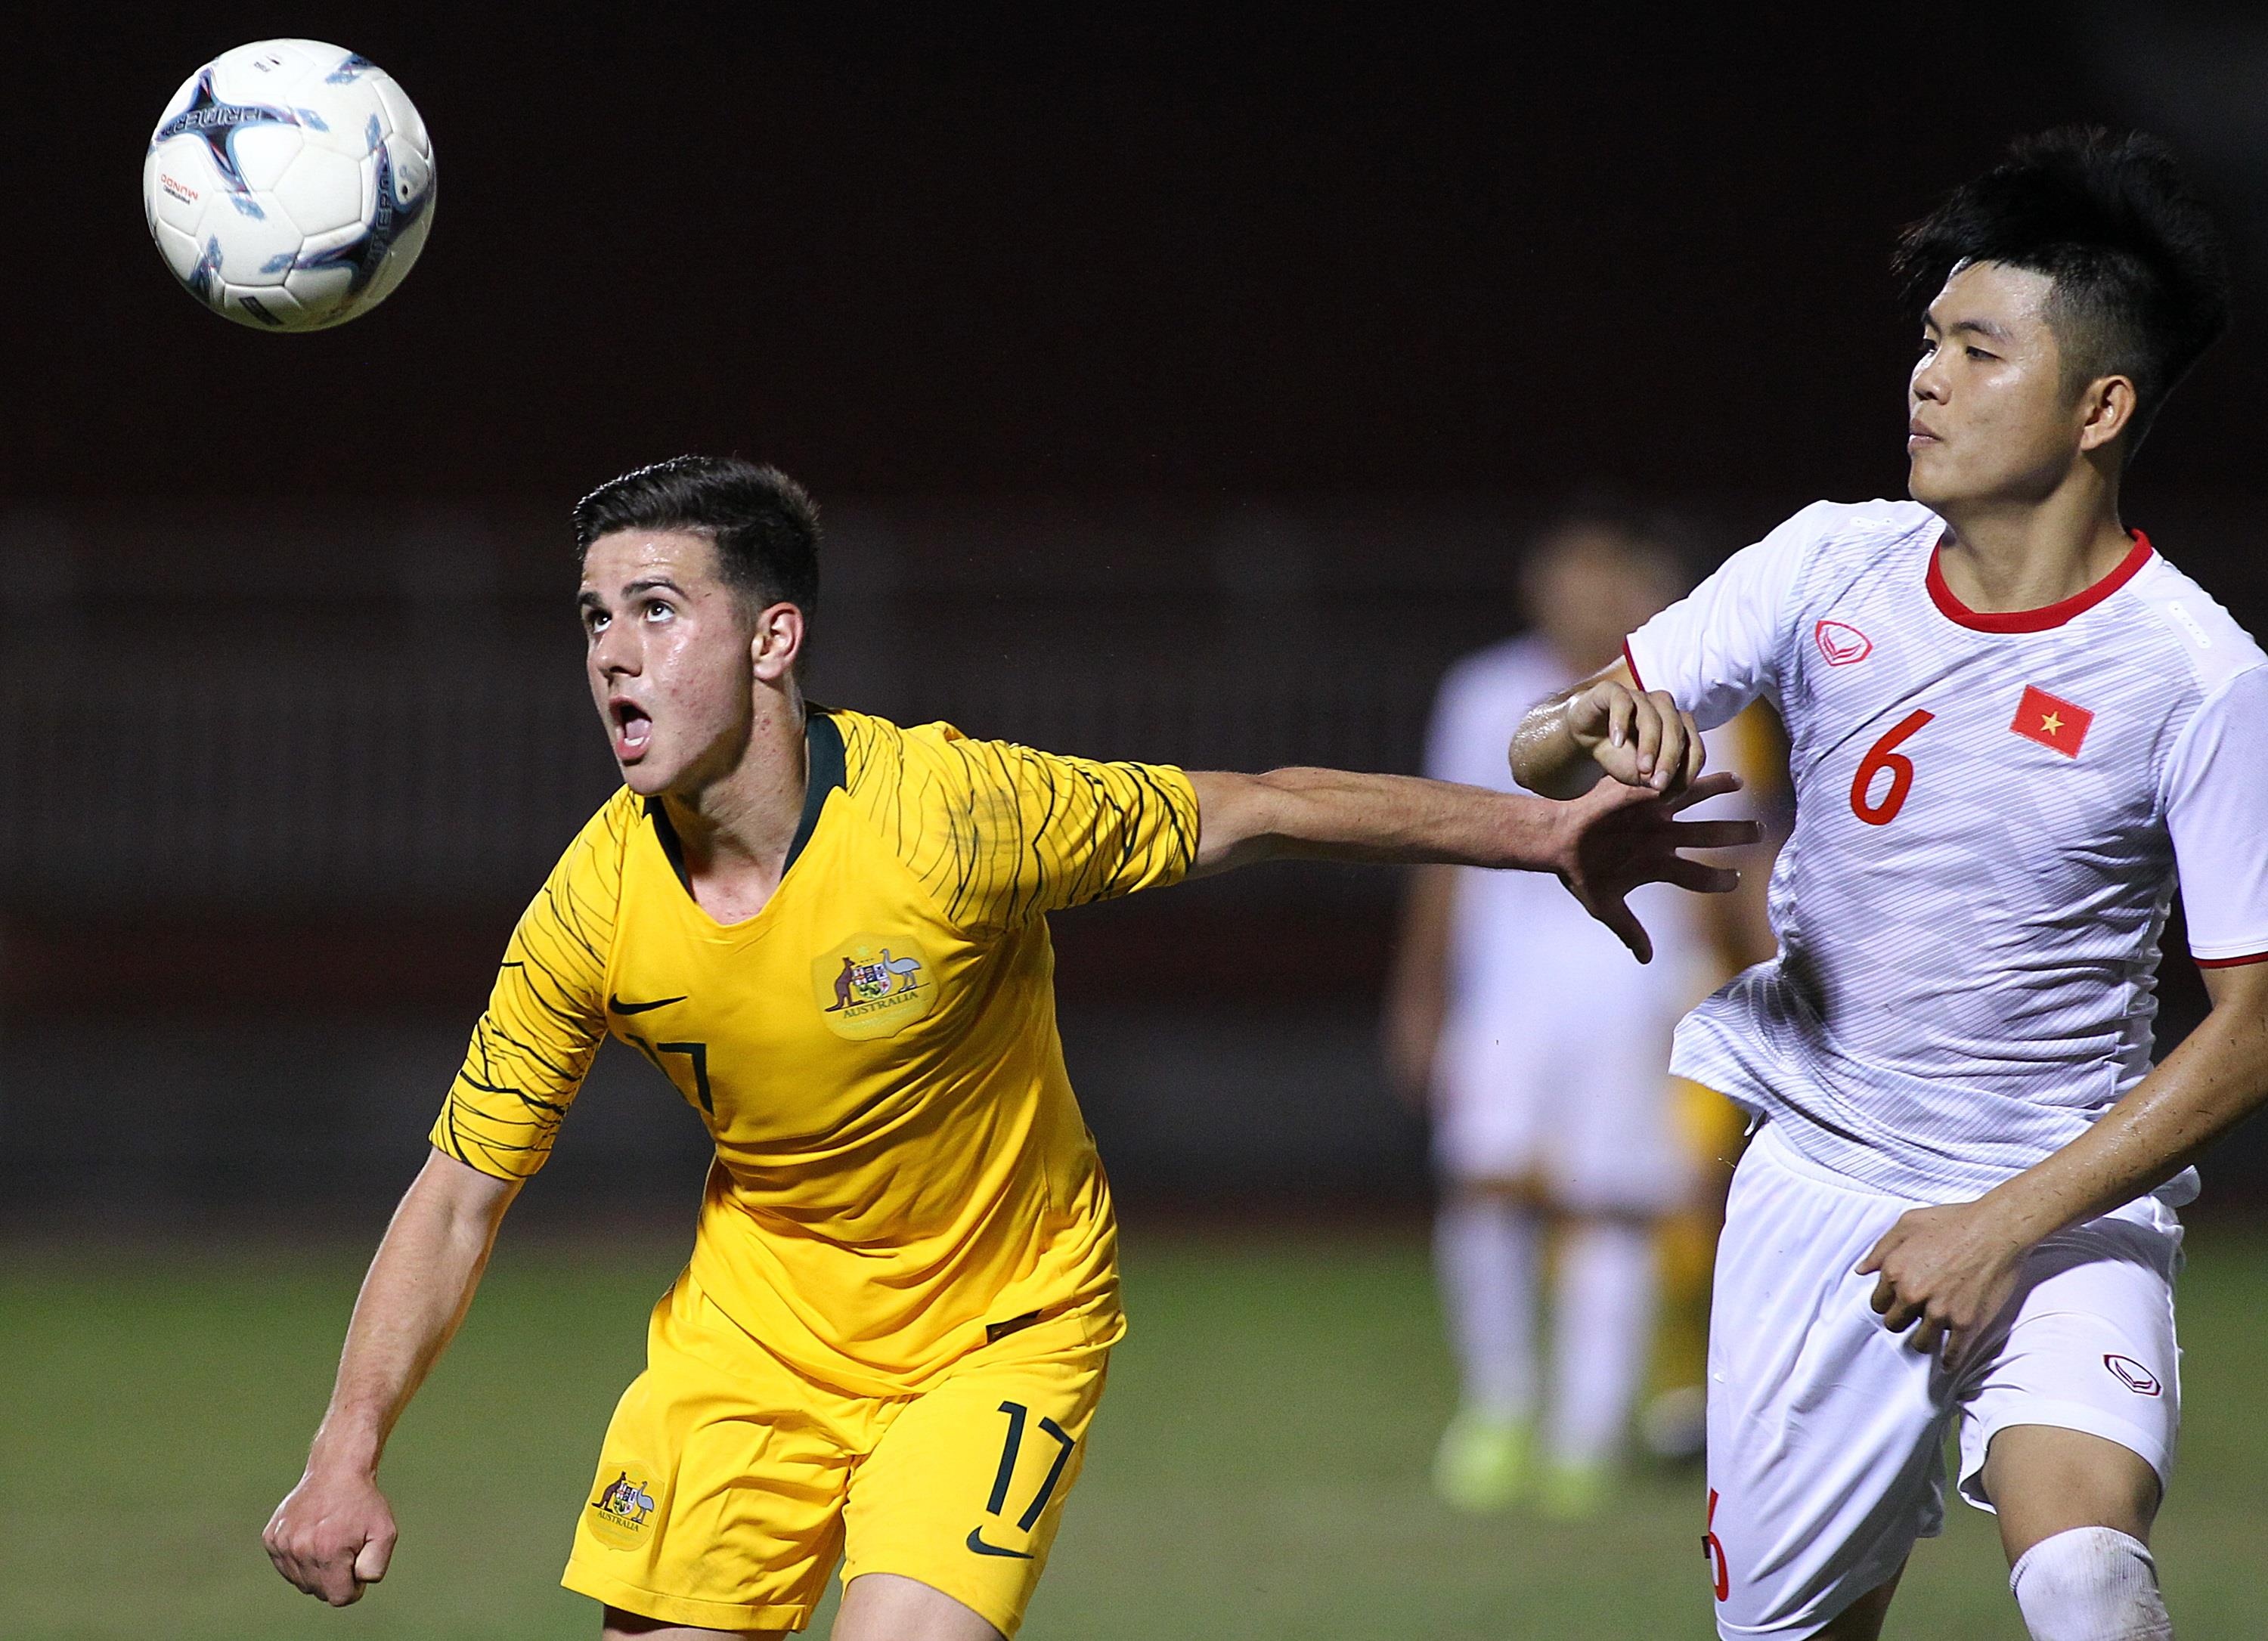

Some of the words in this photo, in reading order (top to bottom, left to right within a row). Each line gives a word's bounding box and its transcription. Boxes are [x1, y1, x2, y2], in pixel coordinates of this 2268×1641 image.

[160, 173, 199, 200] MUNDO
[1850, 709, 1935, 825] 6
[844, 991, 919, 1019] AUSTRALIA
[624, 1033, 716, 1116] 17
[985, 1401, 1077, 1534] 17
[597, 1510, 640, 1532] AUSTRALIA
